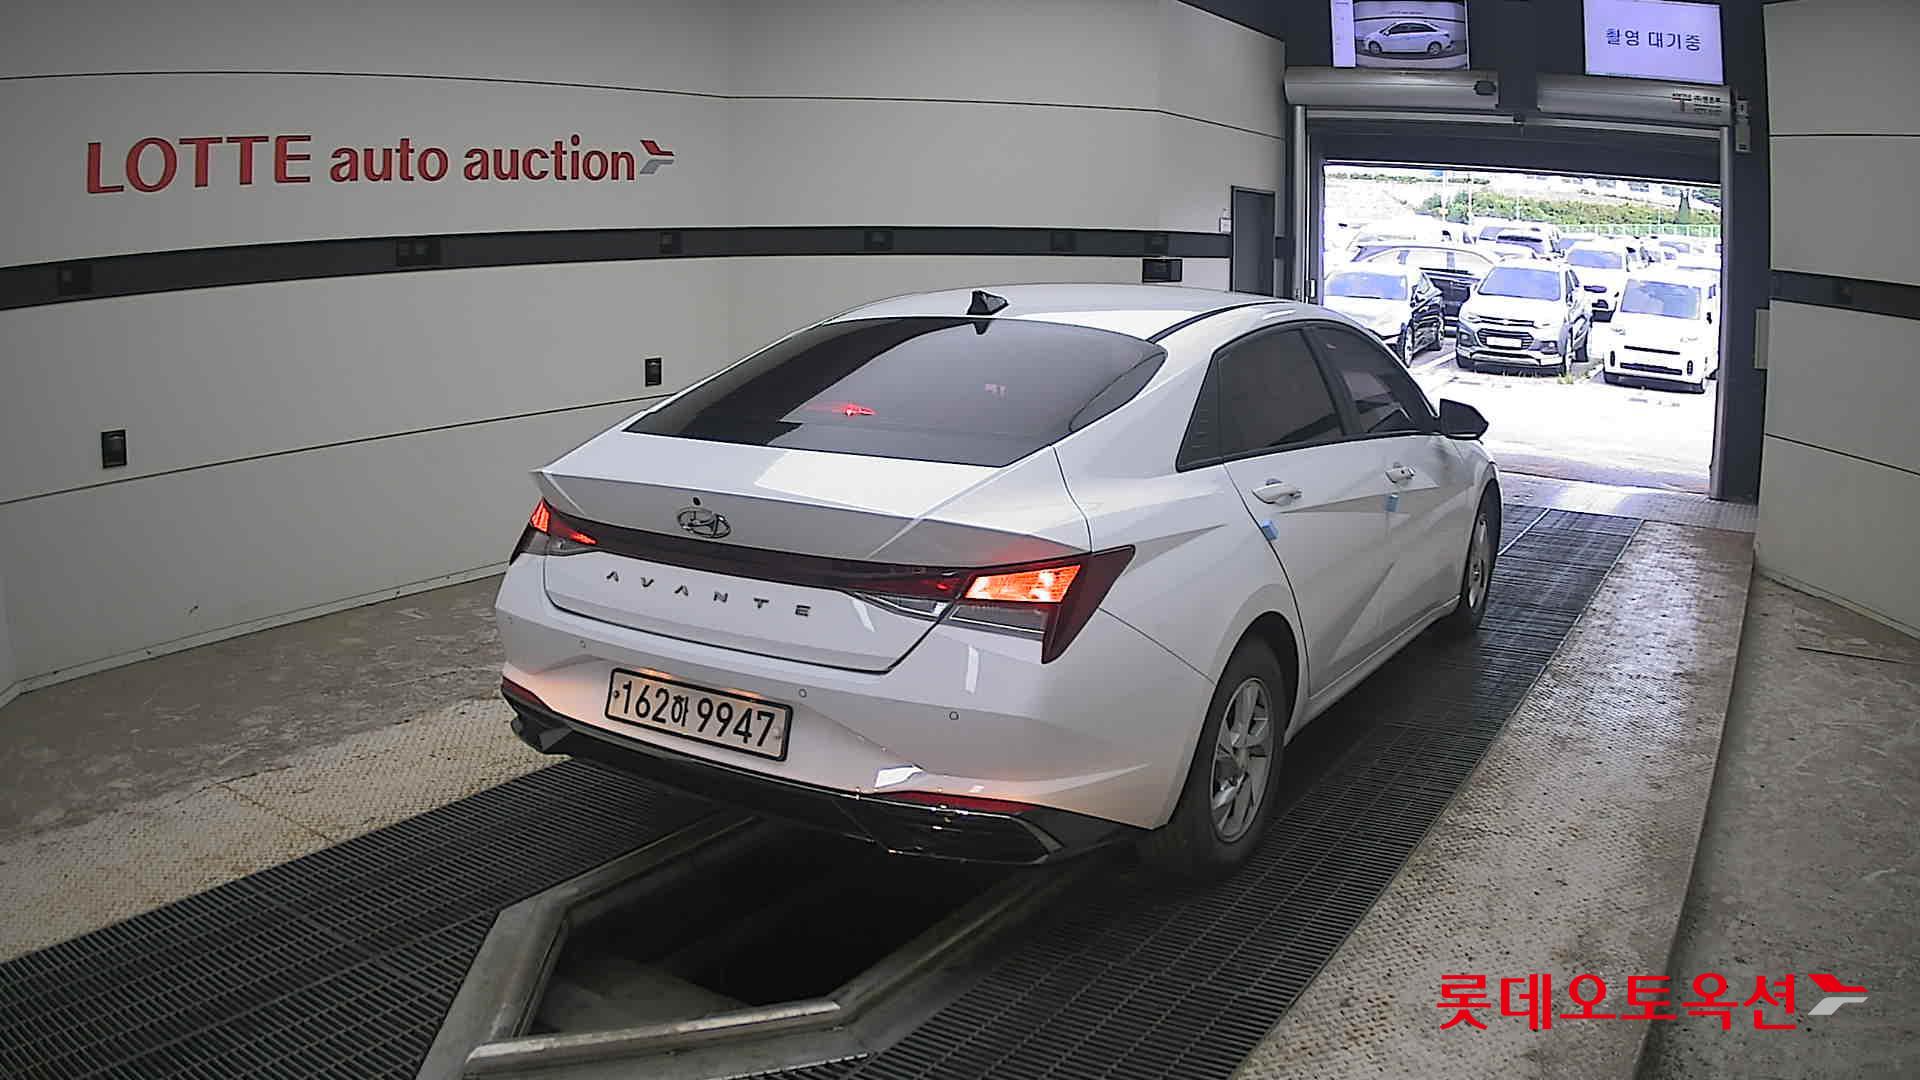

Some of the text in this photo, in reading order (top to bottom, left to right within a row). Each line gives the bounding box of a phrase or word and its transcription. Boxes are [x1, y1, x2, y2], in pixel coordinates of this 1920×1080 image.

[1647, 30, 1701, 52] 대기중
[86, 133, 636, 194] LOTTE auto auction
[606, 570, 811, 617] AVANTE
